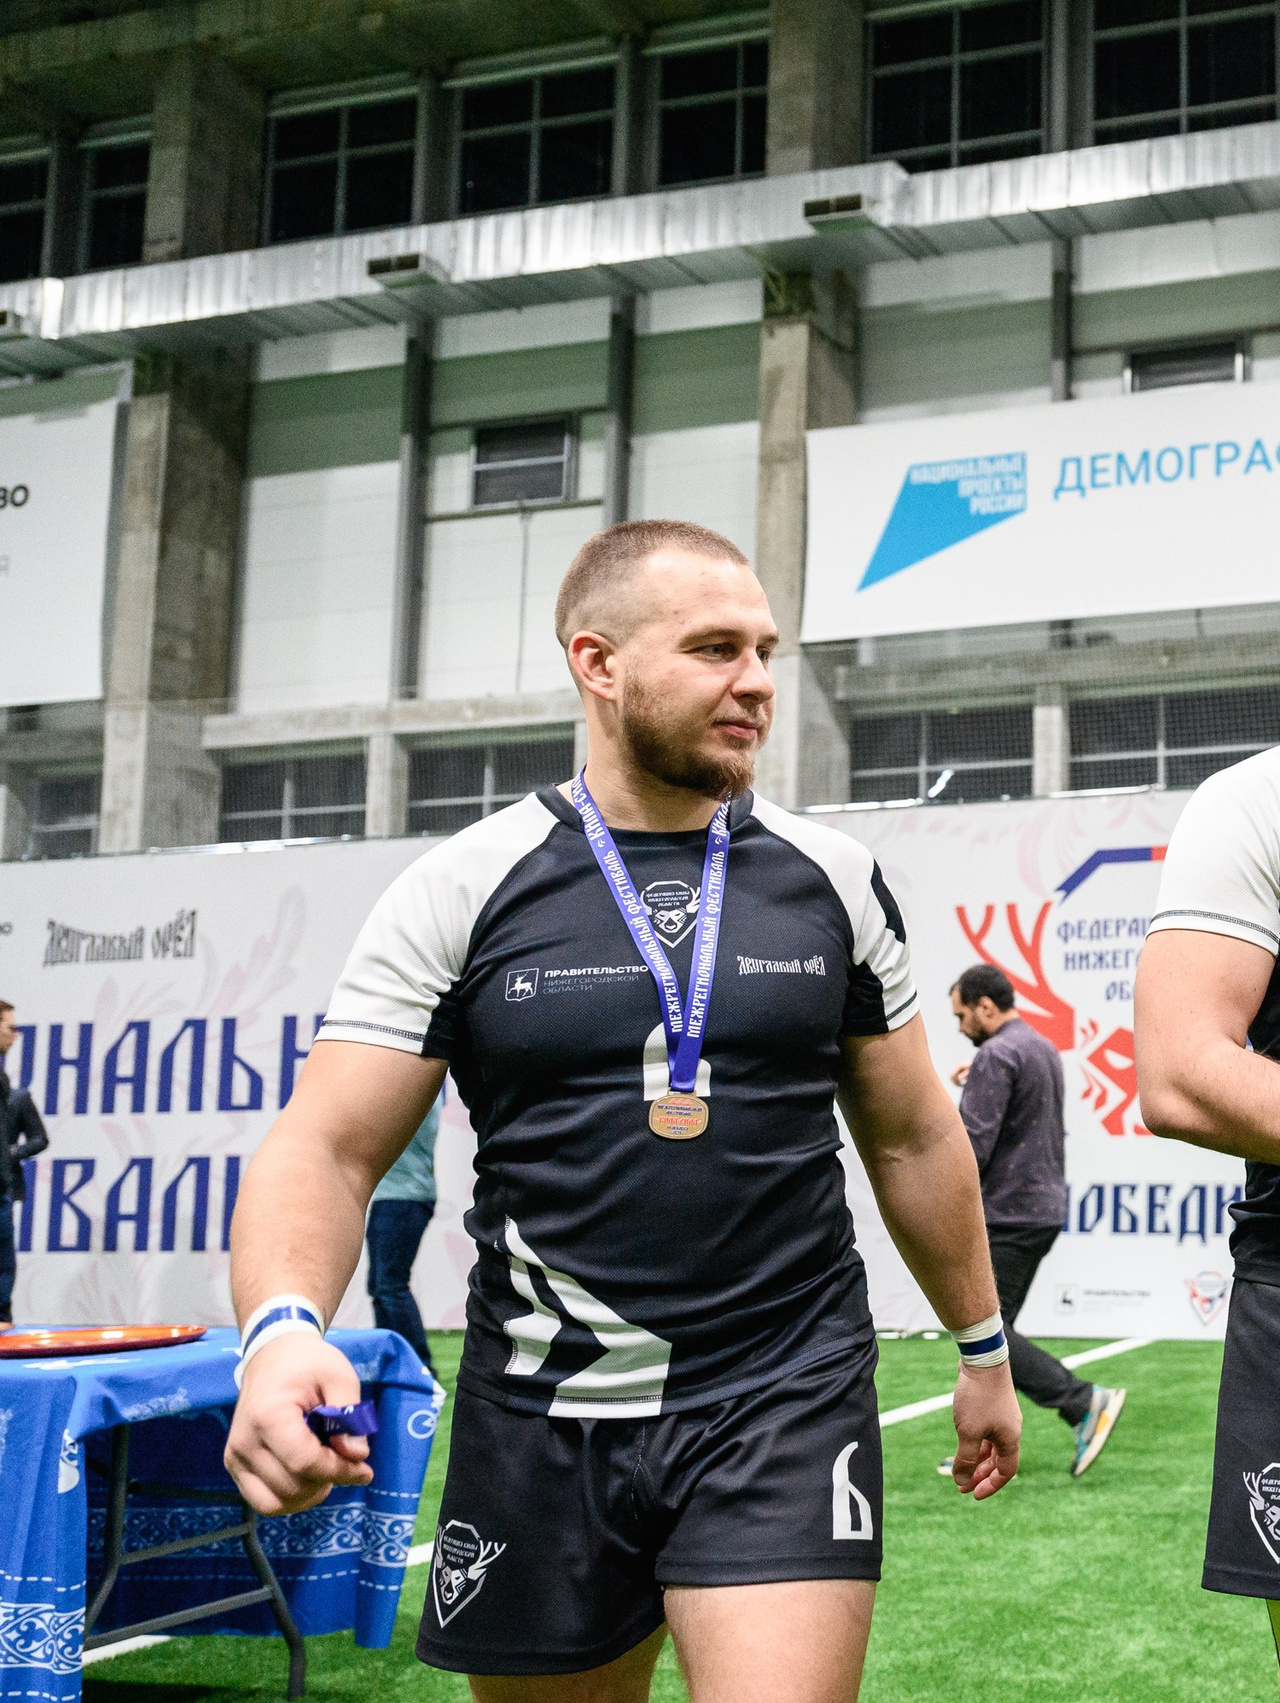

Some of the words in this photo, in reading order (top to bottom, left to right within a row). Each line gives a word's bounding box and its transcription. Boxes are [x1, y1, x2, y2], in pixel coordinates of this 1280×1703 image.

[603, 850, 643, 915] ФЕСТИВАЛЬ
[544, 965, 649, 978] ПРАВИТЕЛЬСТВО
[630, 915, 683, 1033] МЕЖРЕГИОНАЛЬНЫЙ
[687, 917, 718, 1038] МЕЖРЕГИОНАЛЬНЫЙ
[705, 851, 725, 915] ФЕСТИВАЛЬ
